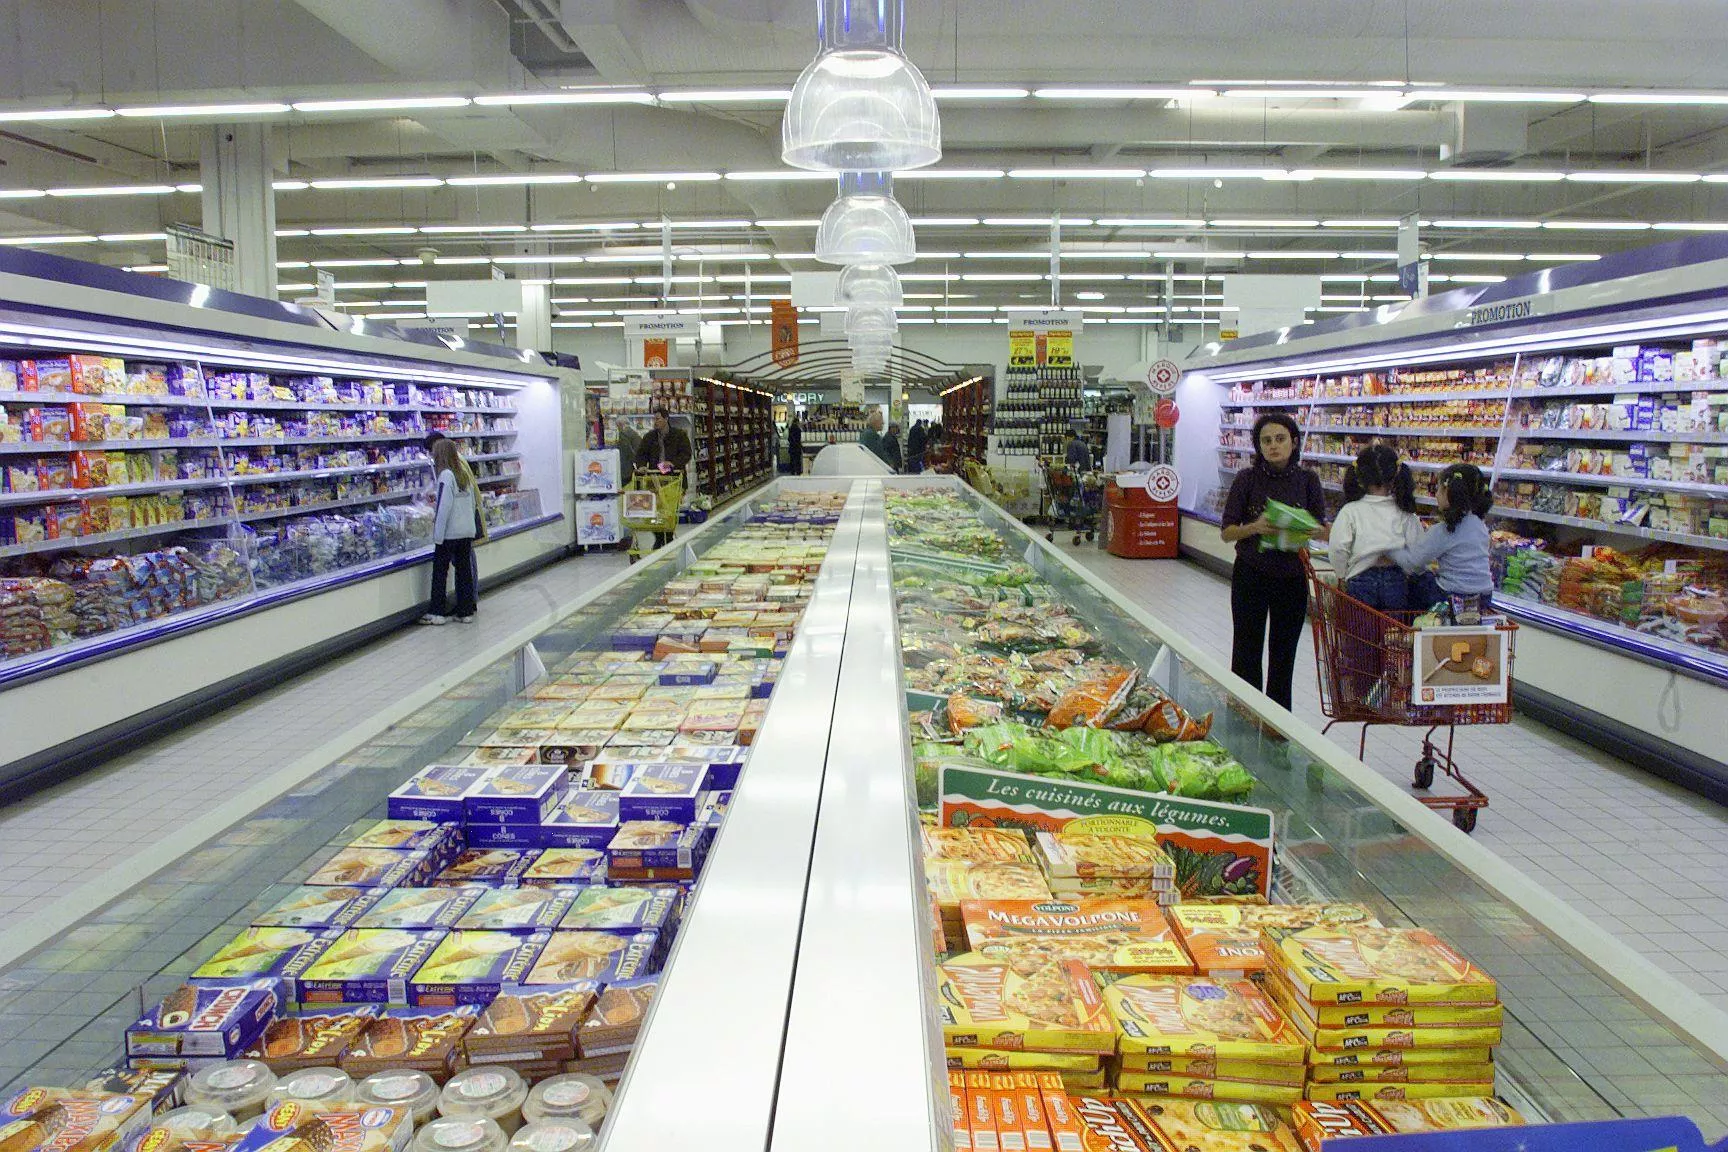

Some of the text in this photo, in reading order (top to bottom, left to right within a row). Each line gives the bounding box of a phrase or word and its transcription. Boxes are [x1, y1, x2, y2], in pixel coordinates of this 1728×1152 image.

[1471, 301, 1531, 325] PROMOTION
[987, 778, 1019, 797] Les
[1025, 786, 1102, 809] cuisinés
[1107, 801, 1145, 815] aux
